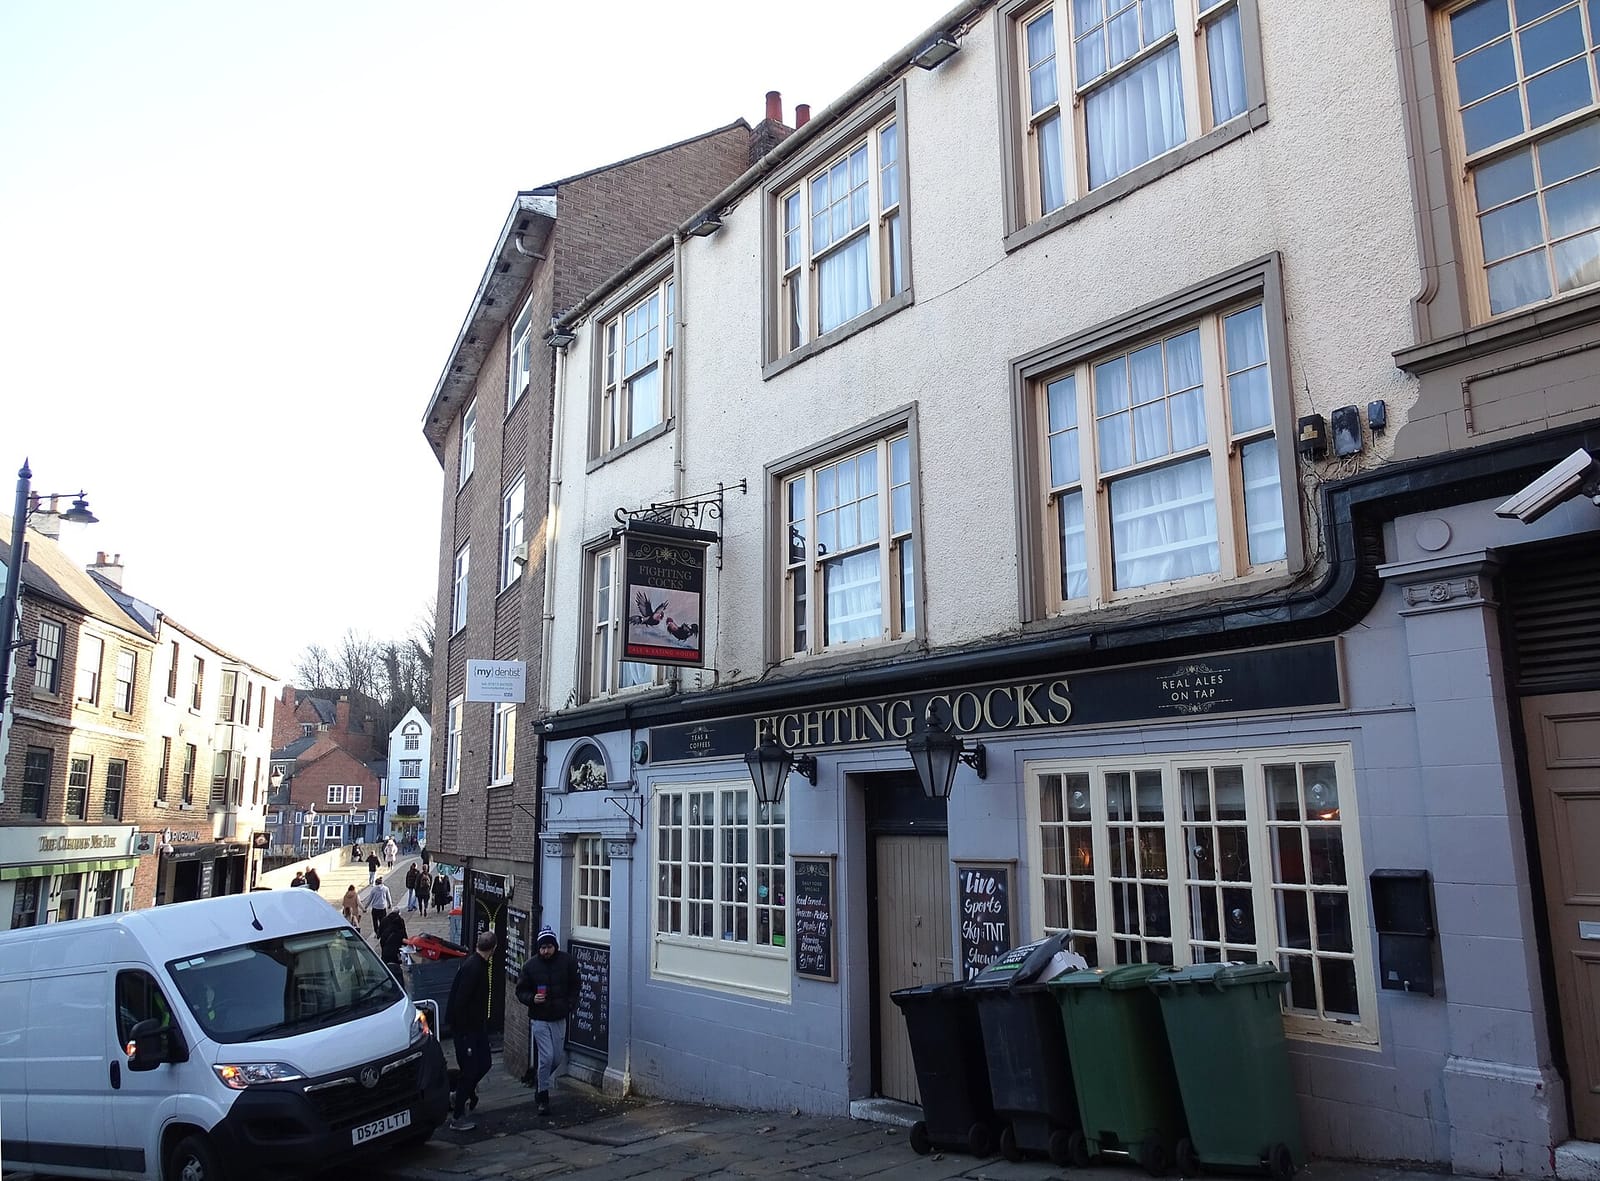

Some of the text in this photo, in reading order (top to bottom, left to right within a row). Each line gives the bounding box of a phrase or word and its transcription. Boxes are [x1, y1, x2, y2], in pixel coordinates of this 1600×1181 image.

[639, 565, 692, 580] FIGHTING
[647, 577, 684, 590] COCKS
[1162, 674, 1224, 690] REAL ALES
[1171, 688, 1216, 701] ON TAP
[753, 680, 1072, 751] FIGHTING COCKS
[691, 733, 703, 741] TEAS
[689, 741, 711, 750] COFFEES
[965, 872, 996, 895] Live
[964, 896, 1002, 918] Sports
[962, 920, 980, 945] Sky
[983, 922, 1005, 941] TNT
[356, 1112, 407, 1141] DS23 LTT
